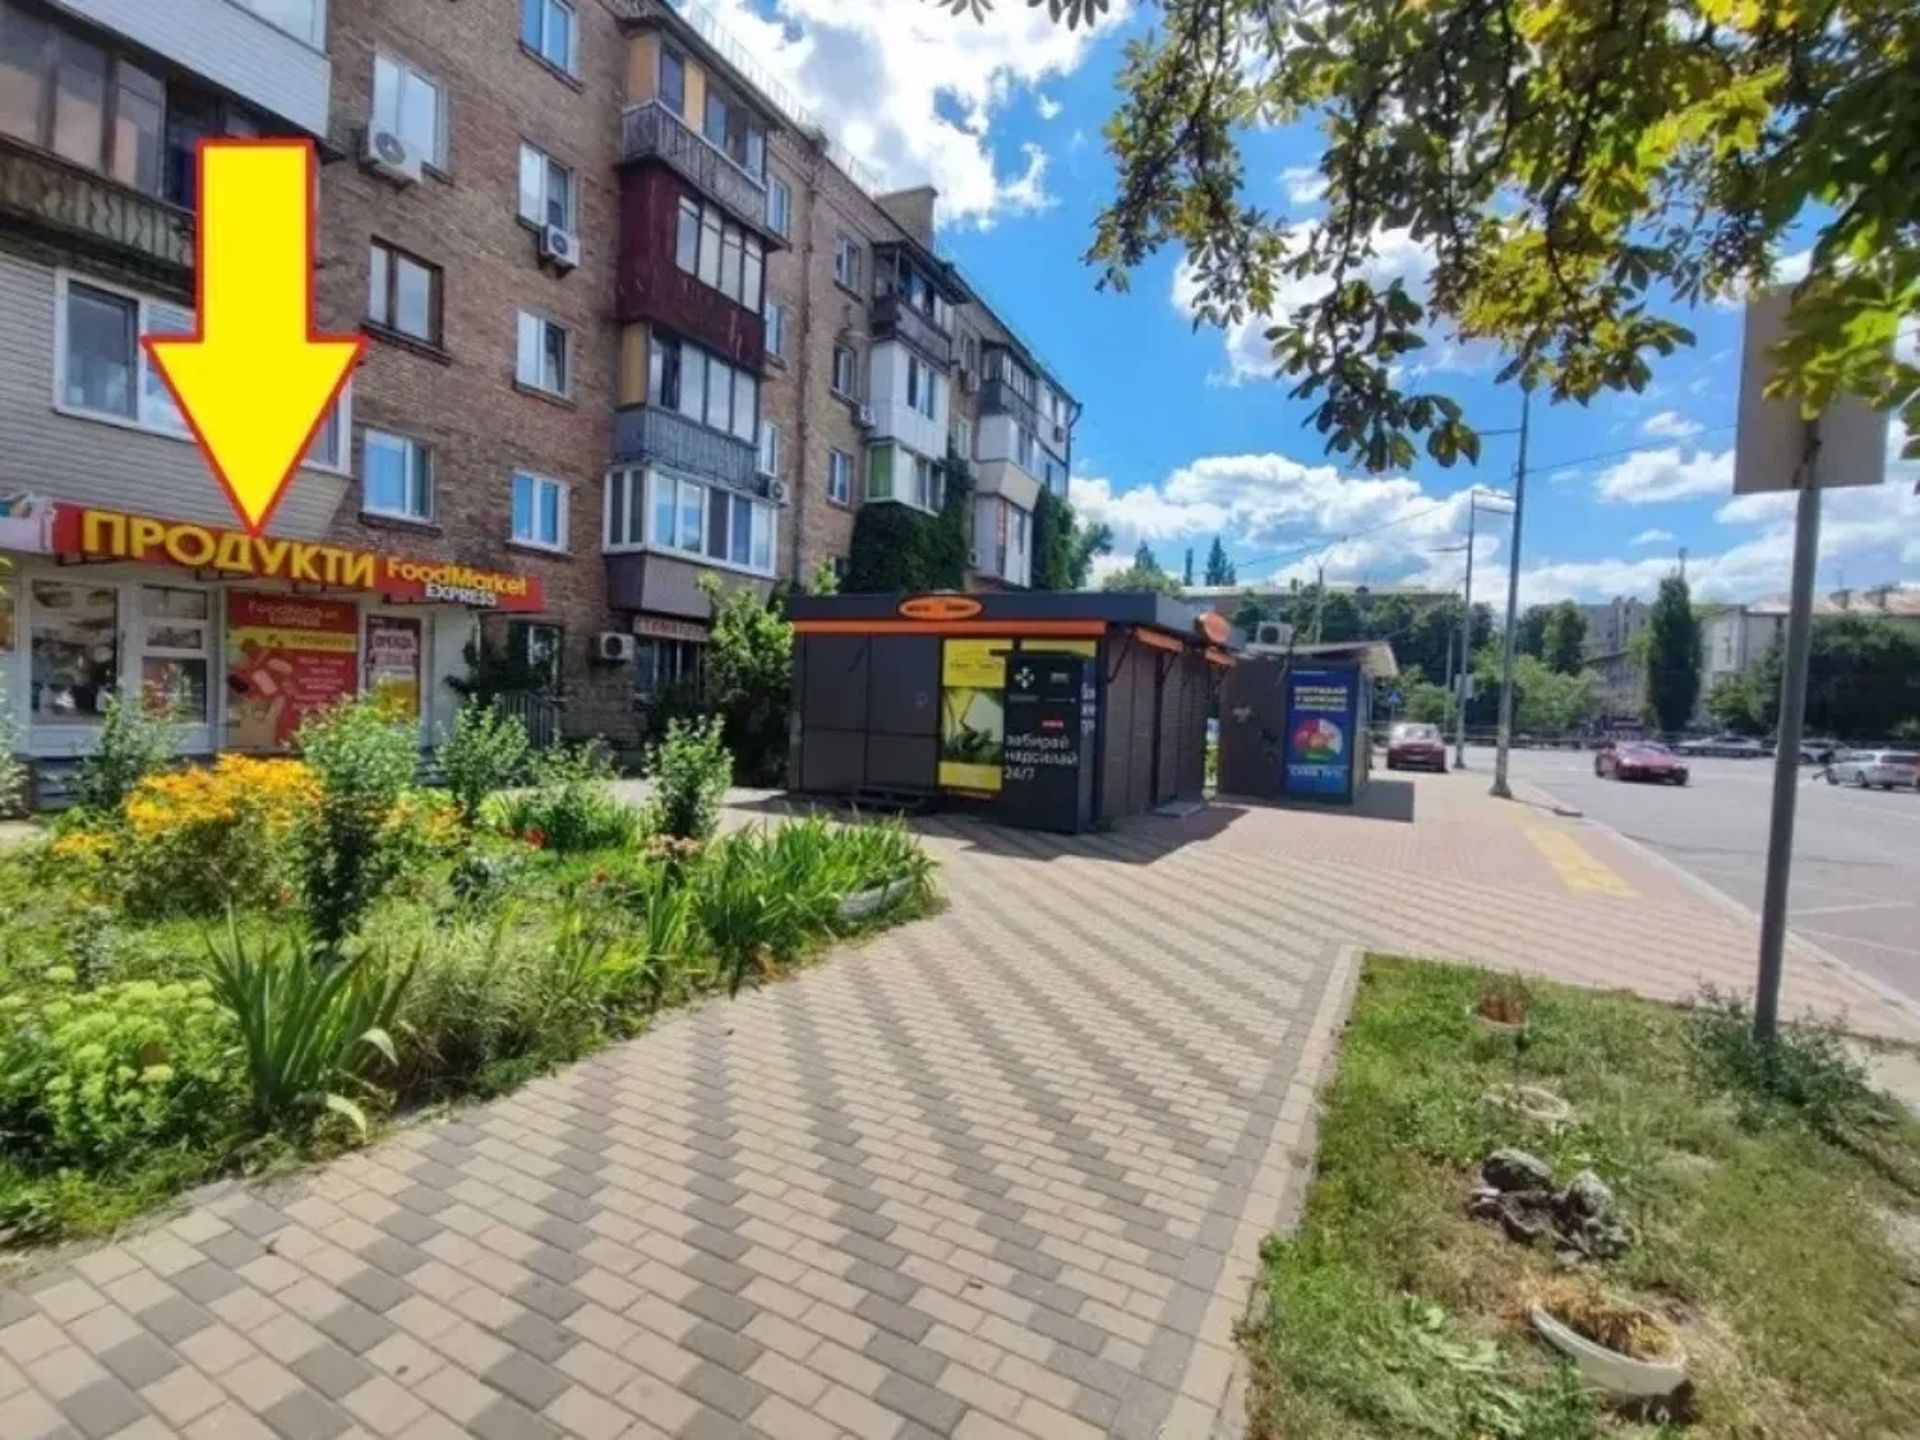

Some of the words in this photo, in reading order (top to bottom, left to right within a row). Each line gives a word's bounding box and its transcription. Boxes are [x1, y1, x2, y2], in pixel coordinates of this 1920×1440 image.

[82, 509, 374, 588] ПРОДУКТИ
[386, 556, 527, 596] FoodMarket
[425, 583, 498, 606] EXPRESS
